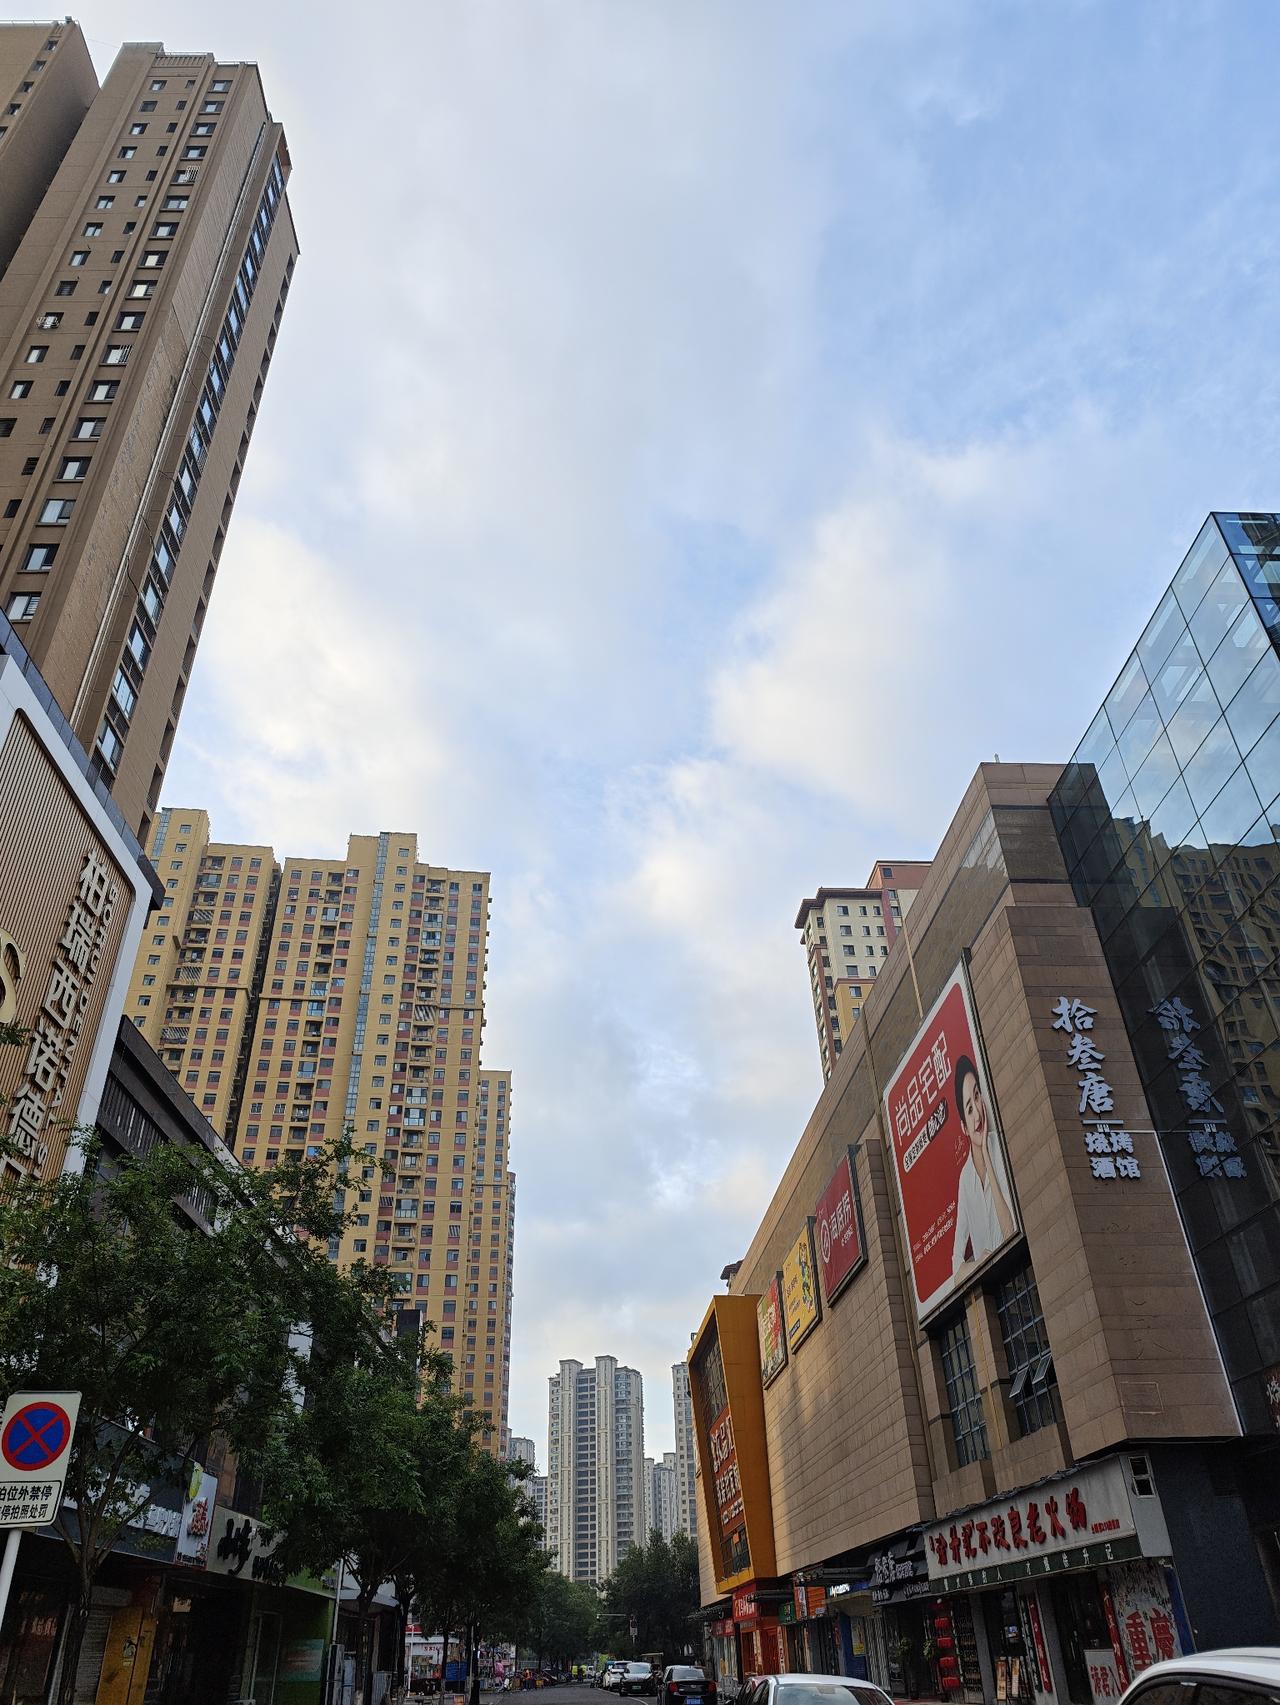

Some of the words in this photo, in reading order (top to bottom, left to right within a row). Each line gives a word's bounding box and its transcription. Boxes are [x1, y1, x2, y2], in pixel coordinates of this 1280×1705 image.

[1050, 996, 1115, 1115] 拾叁唐
[894, 1030, 952, 1146] 尚品宅配
[1084, 1131, 1135, 1155] 烧烤
[1090, 1156, 1142, 1180] 酒馆
[0, 1504, 48, 1521] 停拍照处罚
